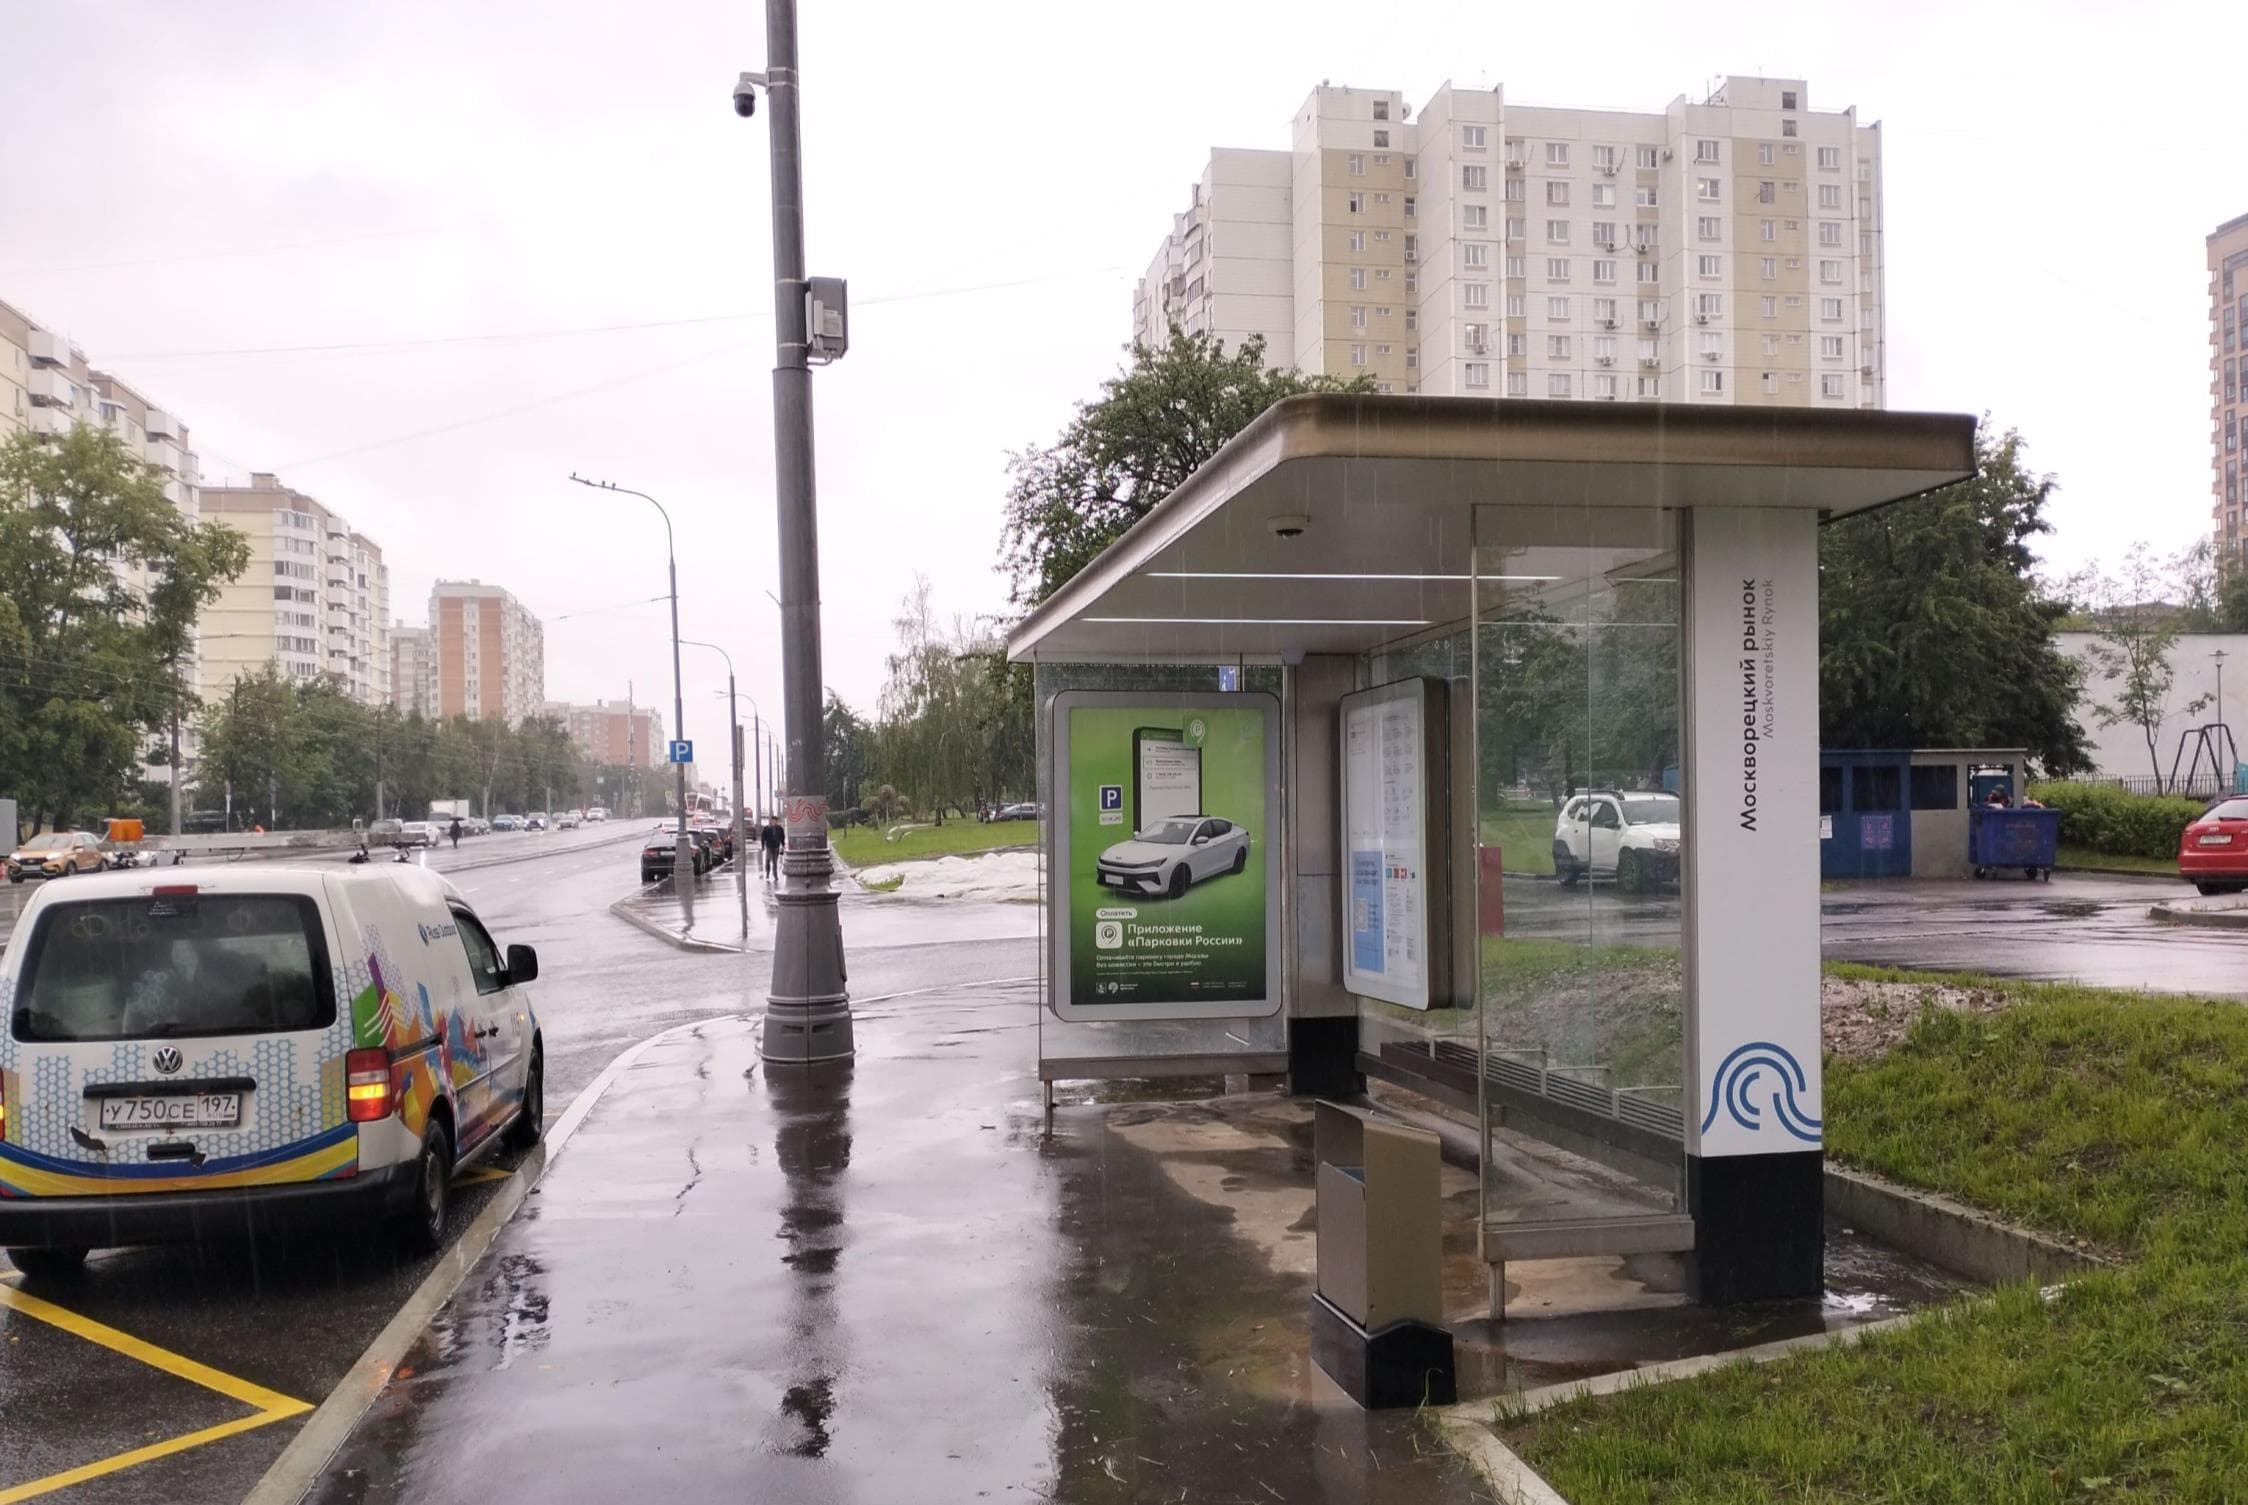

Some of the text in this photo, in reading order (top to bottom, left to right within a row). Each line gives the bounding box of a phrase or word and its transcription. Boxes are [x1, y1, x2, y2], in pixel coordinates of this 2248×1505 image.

[1761, 577, 1776, 739] Moskvoretskiy Rynok
[1739, 579, 1760, 831] Москворецкий рынок
[675, 743, 689, 760] P
[1106, 790, 1117, 807] P
[1127, 923, 1203, 936] Приложение
[1127, 935, 1243, 949] «Парковки России»
[202, 1096, 232, 1112] 197
